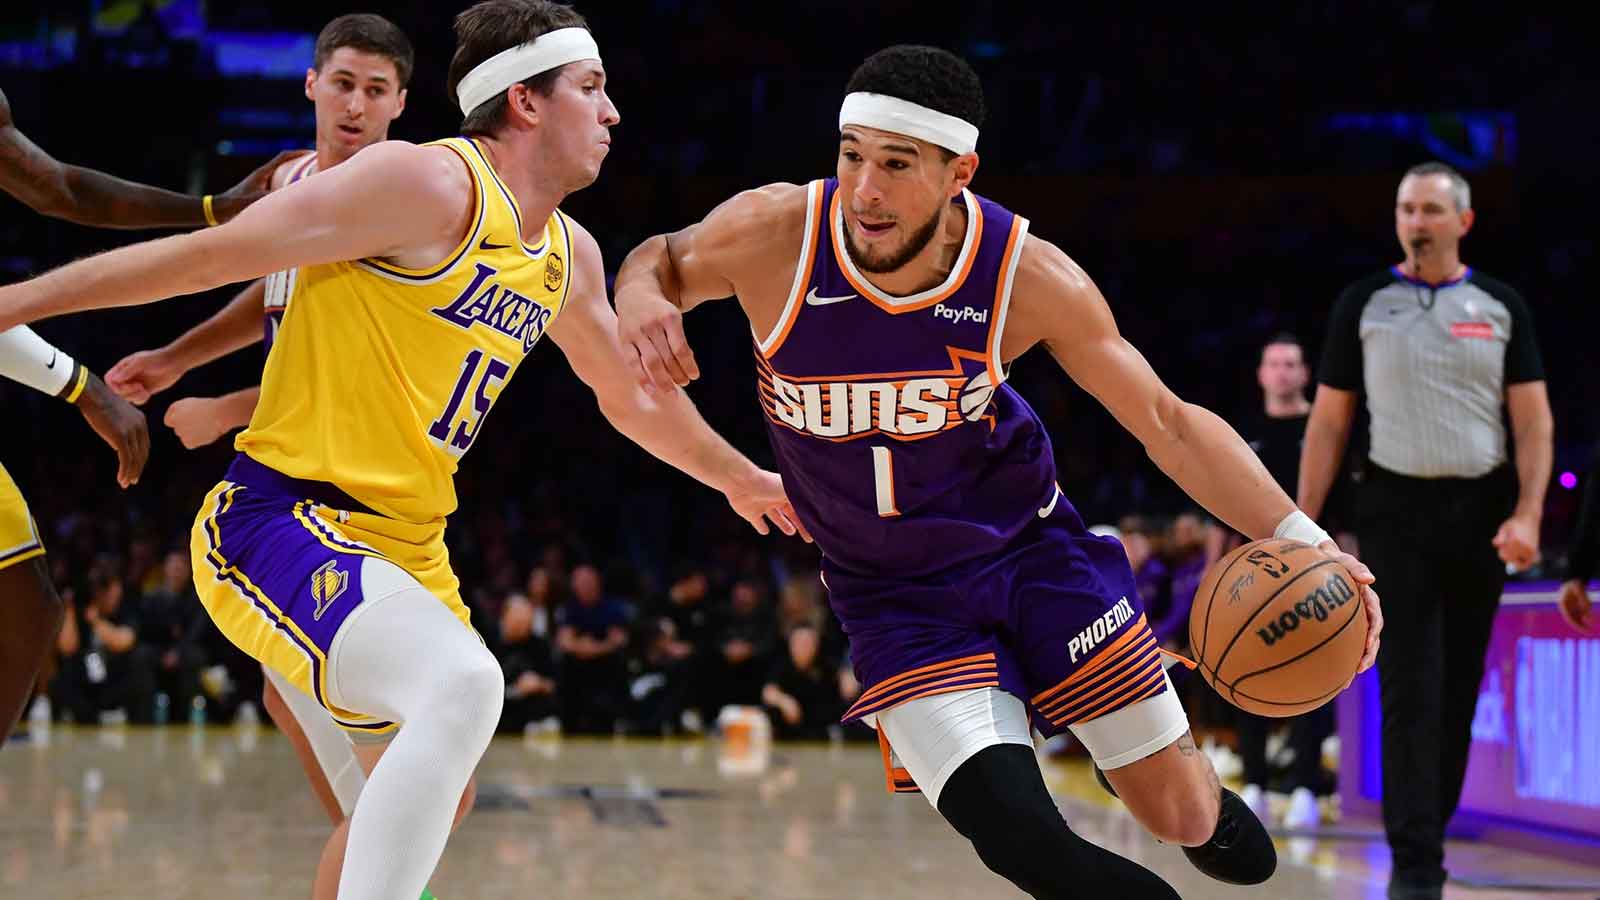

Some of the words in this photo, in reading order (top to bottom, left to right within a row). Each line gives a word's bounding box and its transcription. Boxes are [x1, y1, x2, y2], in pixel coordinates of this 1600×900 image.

[429, 262, 551, 354] LAKERS
[934, 303, 988, 324] PayPal
[428, 348, 510, 453] 15
[871, 446, 902, 518] 1
[1067, 595, 1135, 664] PHOENIX
[1256, 573, 1355, 647] Wilson
